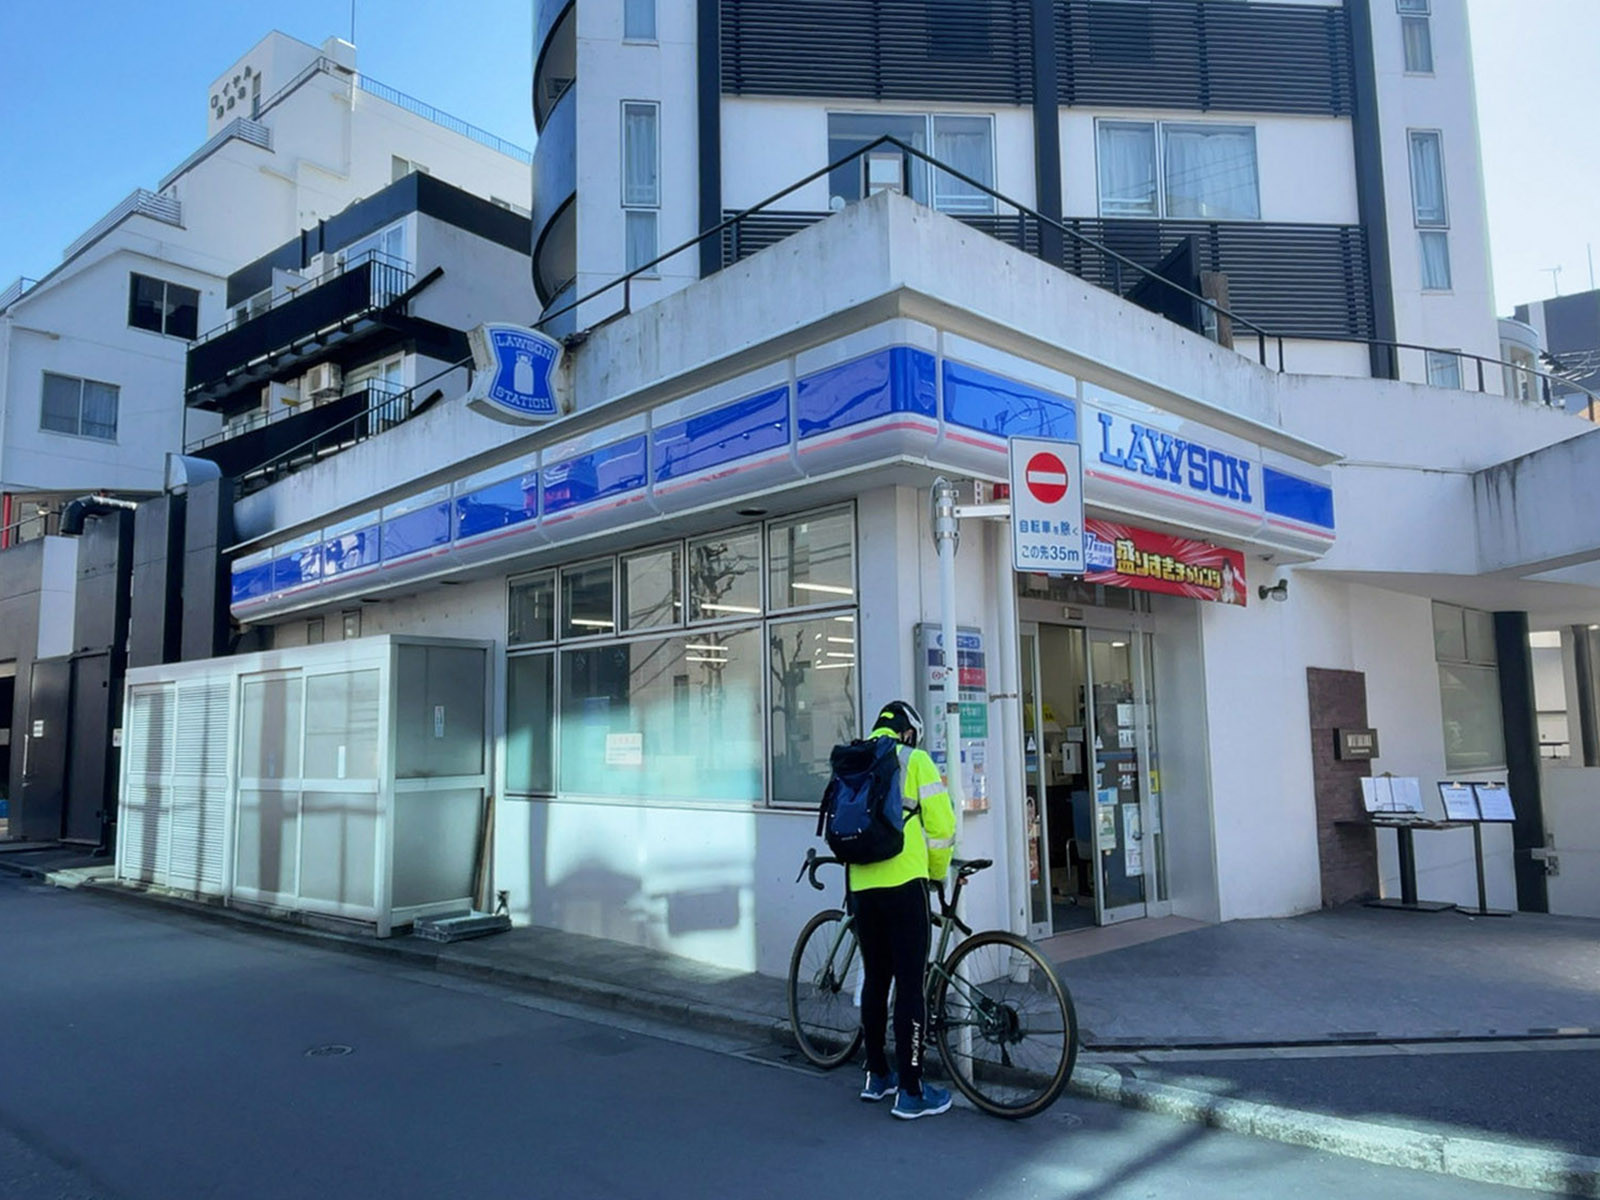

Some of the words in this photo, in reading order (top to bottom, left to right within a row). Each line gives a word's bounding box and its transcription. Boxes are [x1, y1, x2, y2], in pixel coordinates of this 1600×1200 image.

[496, 335, 553, 360] LAWSON
[495, 385, 551, 409] STATION
[1098, 412, 1252, 503] LAWSON
[1019, 519, 1080, 537] 自転車を除く
[1021, 544, 1080, 562] この先35m
[1116, 538, 1222, 590] 盛りすぎチャレンジ
